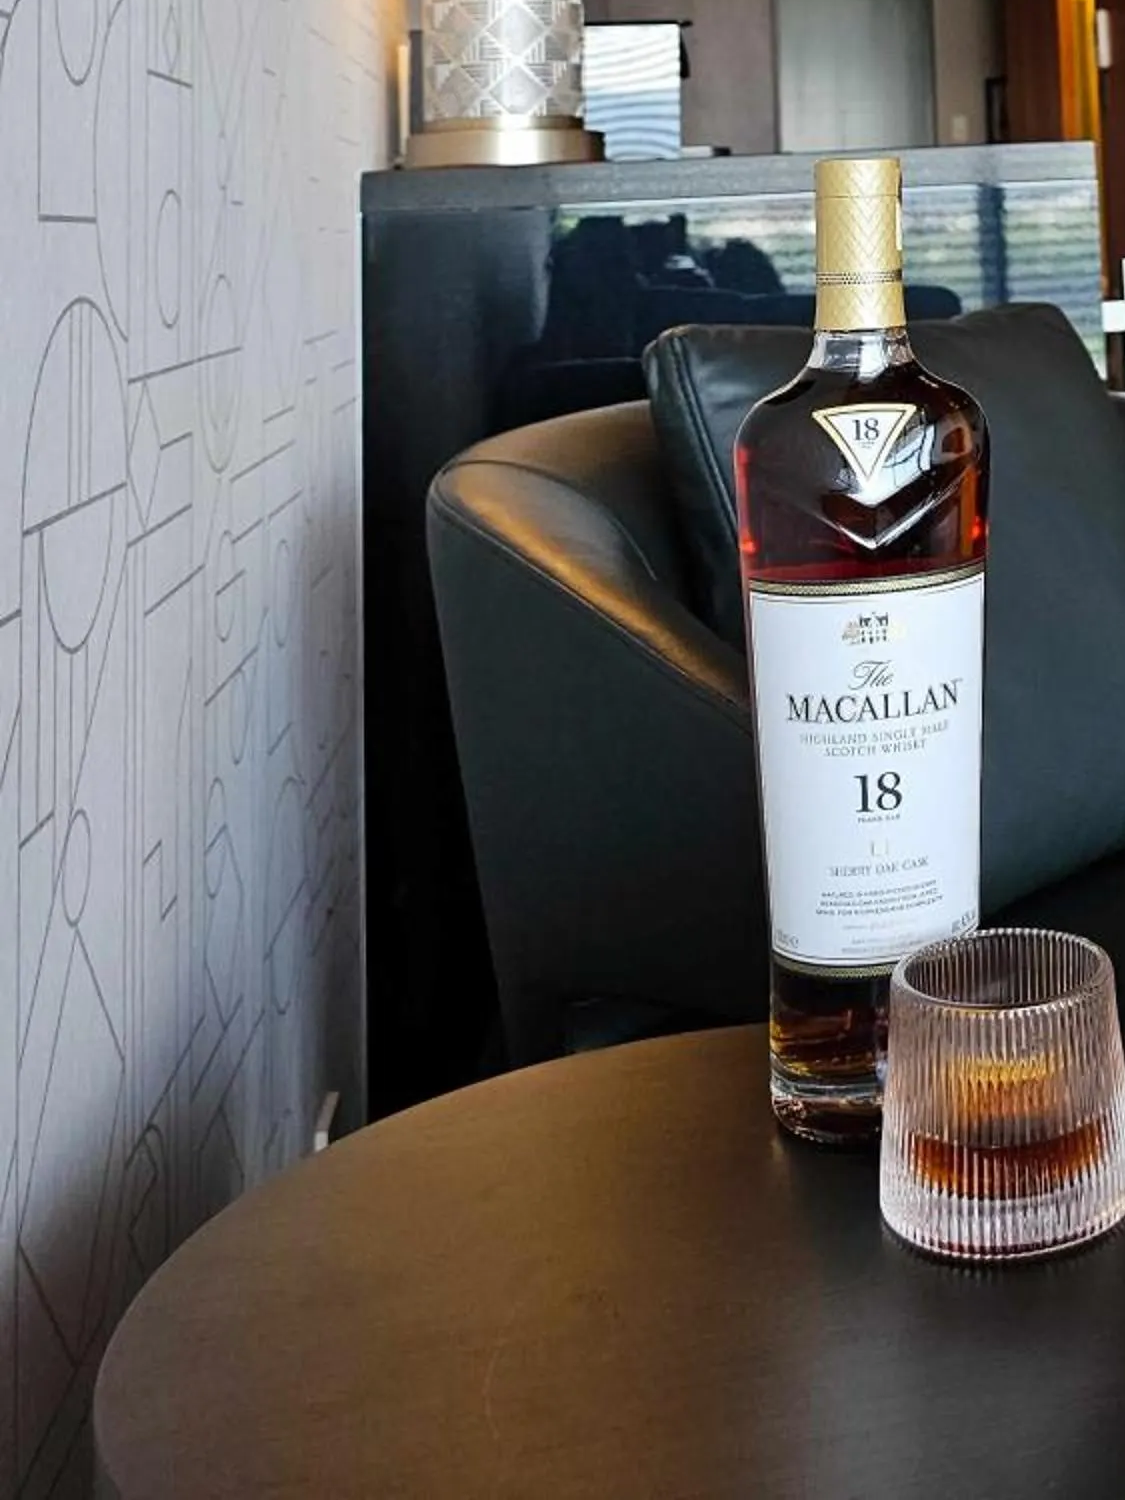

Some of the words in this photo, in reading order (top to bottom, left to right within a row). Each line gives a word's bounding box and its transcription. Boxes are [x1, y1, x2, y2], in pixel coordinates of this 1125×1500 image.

[852, 417, 880, 441] 18
[848, 660, 895, 691] The
[786, 678, 964, 724] MACALLAN
[824, 744, 877, 757] SCOTCH
[853, 771, 902, 813] 18
